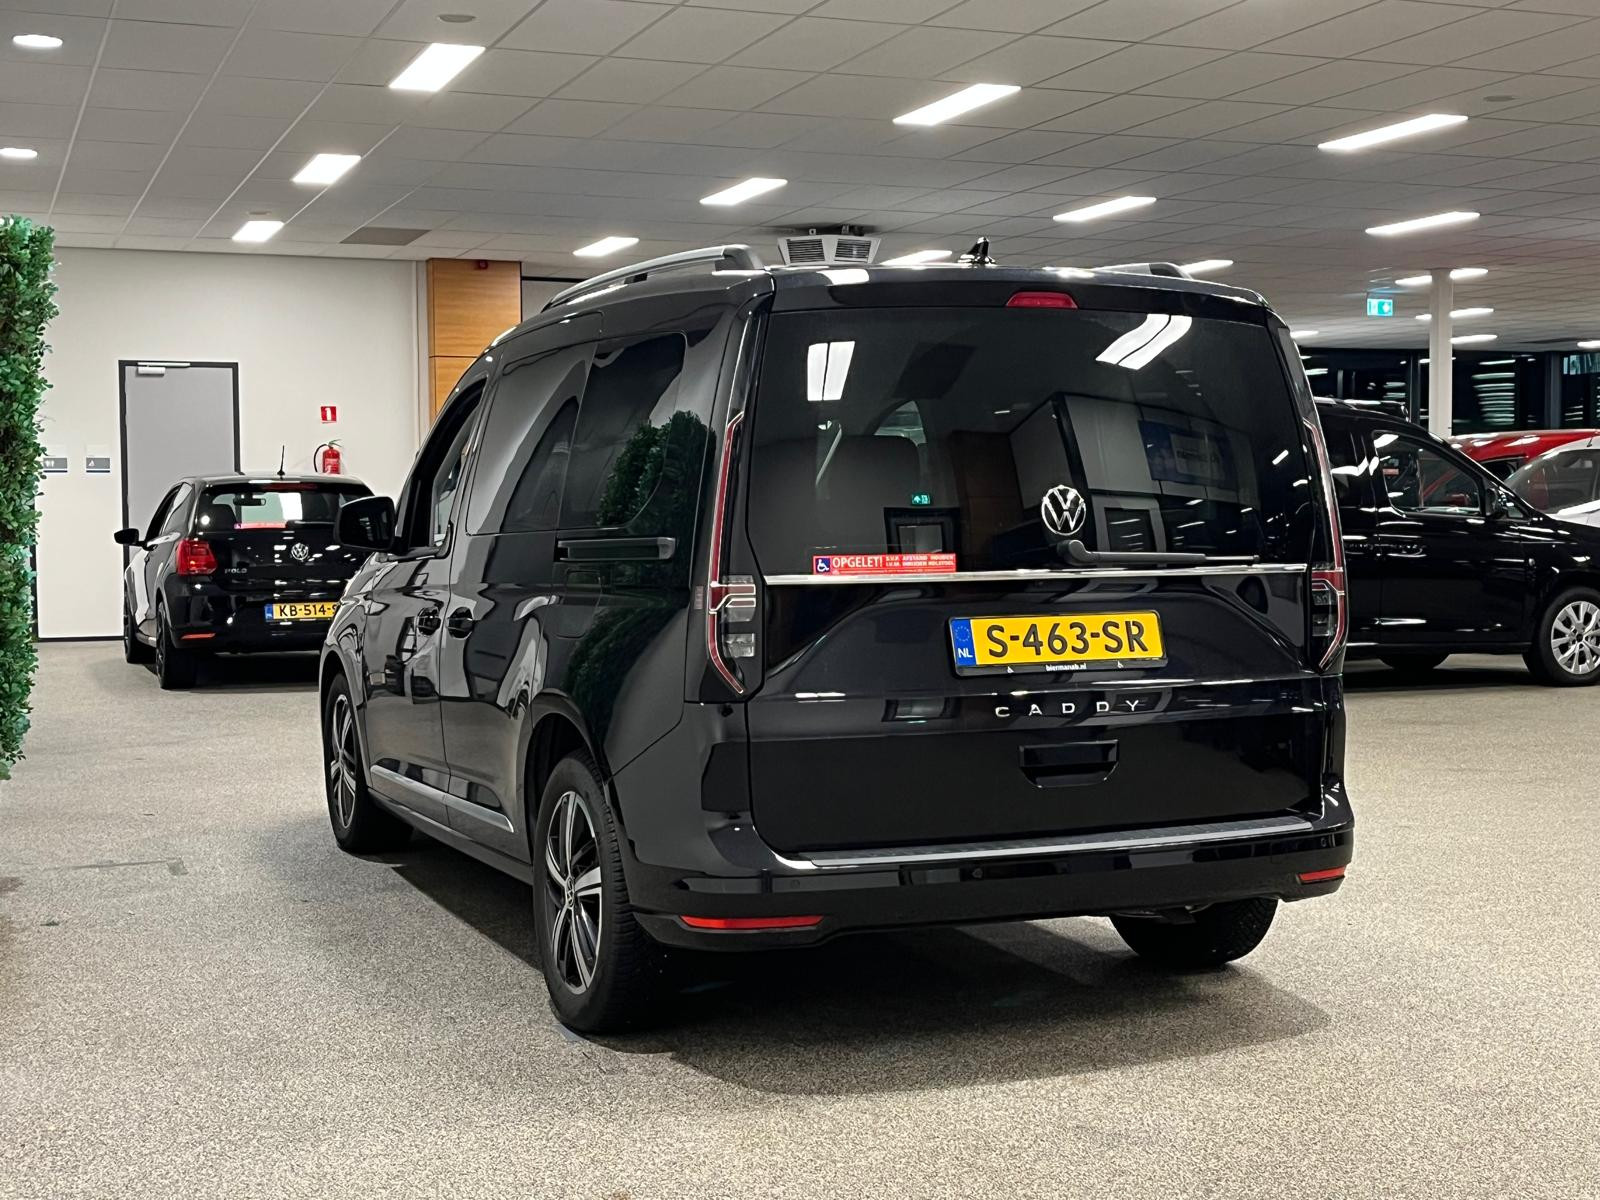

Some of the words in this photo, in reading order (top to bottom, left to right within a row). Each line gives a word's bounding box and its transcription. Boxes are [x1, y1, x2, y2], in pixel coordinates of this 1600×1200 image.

[832, 556, 883, 568] OPGELET!
[986, 620, 1149, 658] S-463-SR
[957, 647, 974, 658] NL
[995, 700, 1139, 717] CADDY
